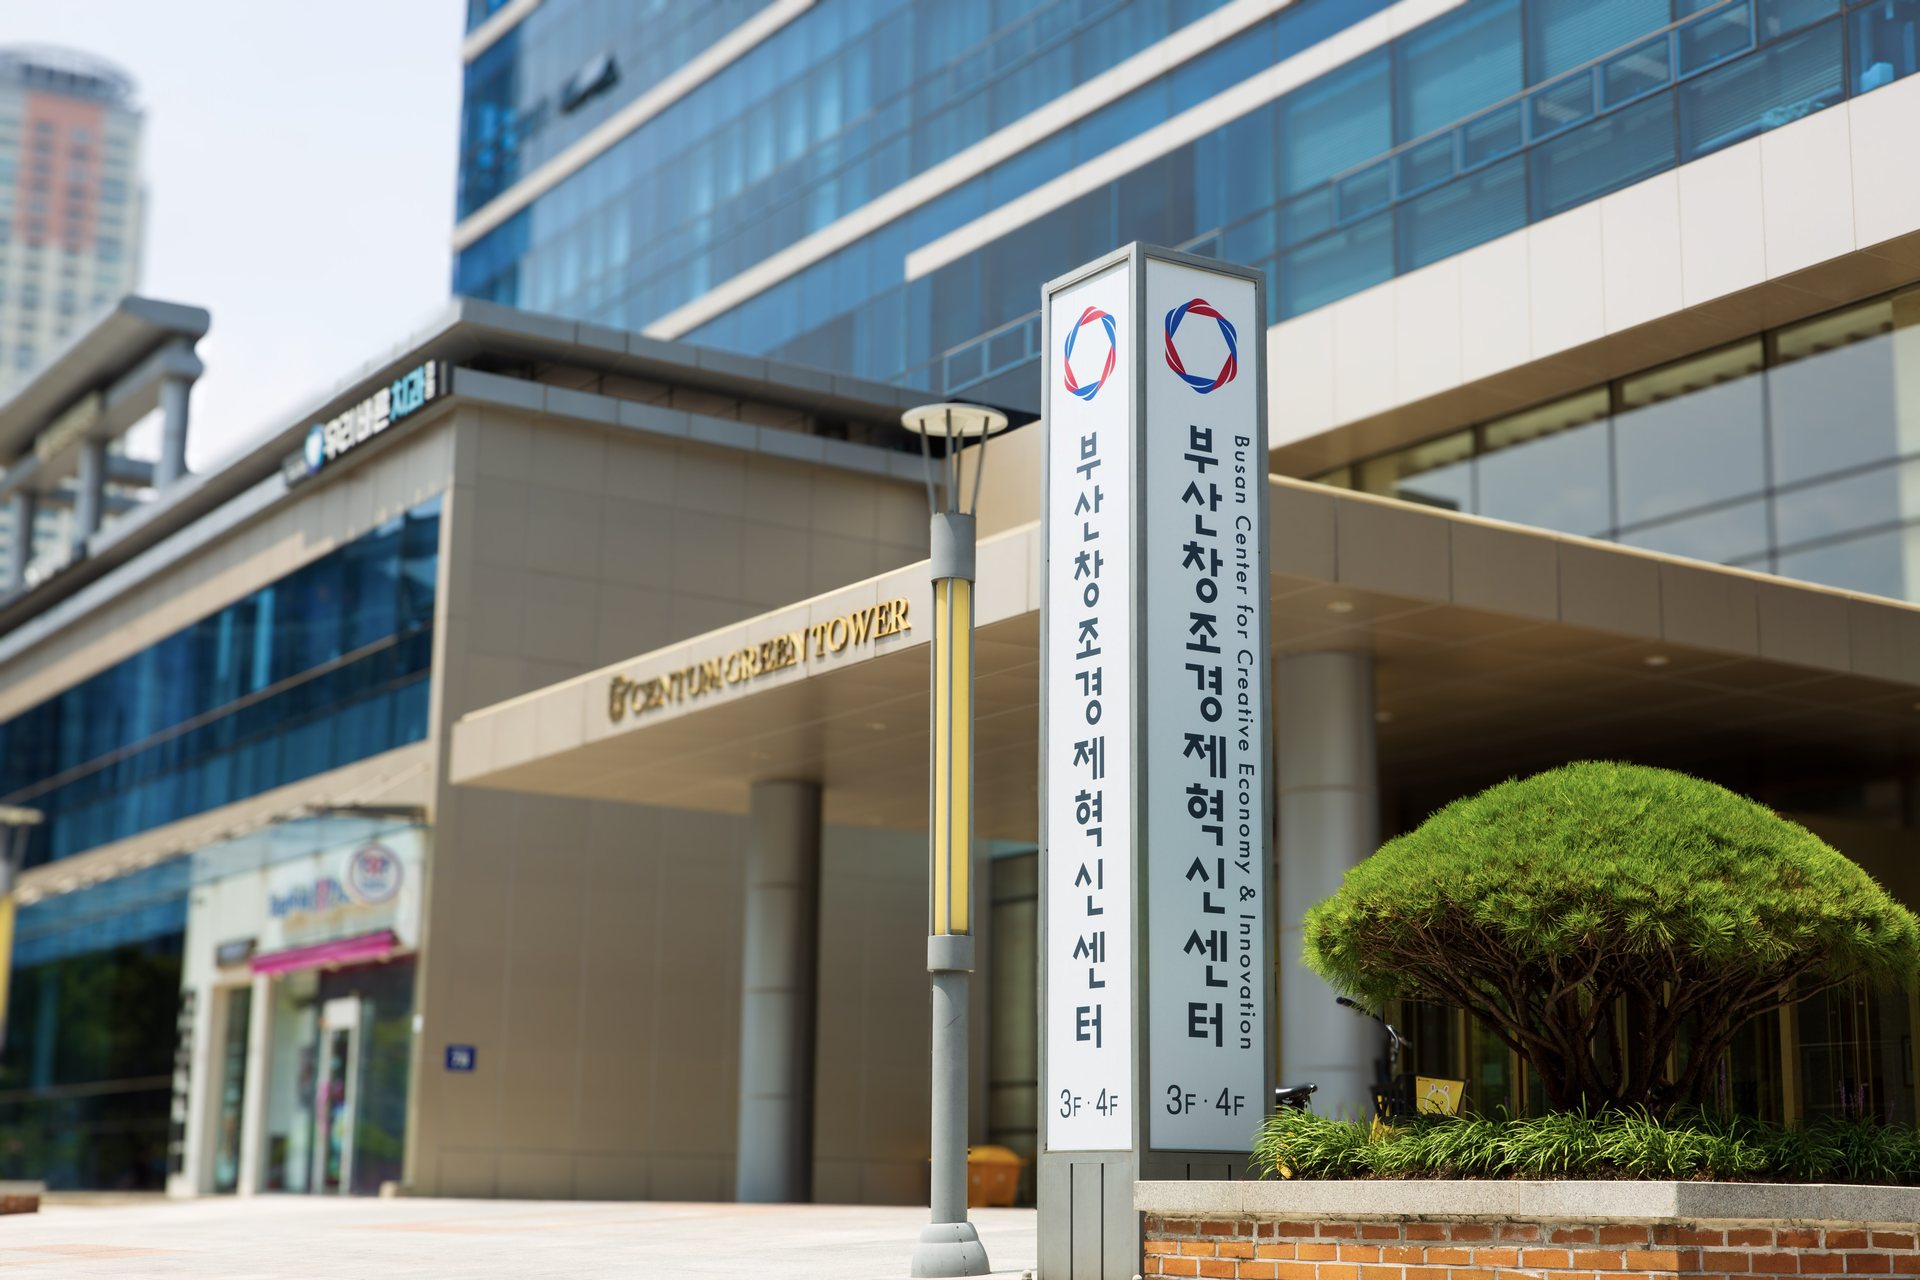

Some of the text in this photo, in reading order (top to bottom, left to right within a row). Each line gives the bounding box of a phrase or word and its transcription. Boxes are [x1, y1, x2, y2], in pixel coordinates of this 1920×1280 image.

[631, 597, 912, 716] CENTUM GREEN TOWER
[1072, 431, 1106, 1049] 부산창조경제혁신센터
[1181, 424, 1229, 1048] 부산창조경제혁신센터
[1234, 435, 1256, 1050] Busan Center for Creative Economy & Innovation
